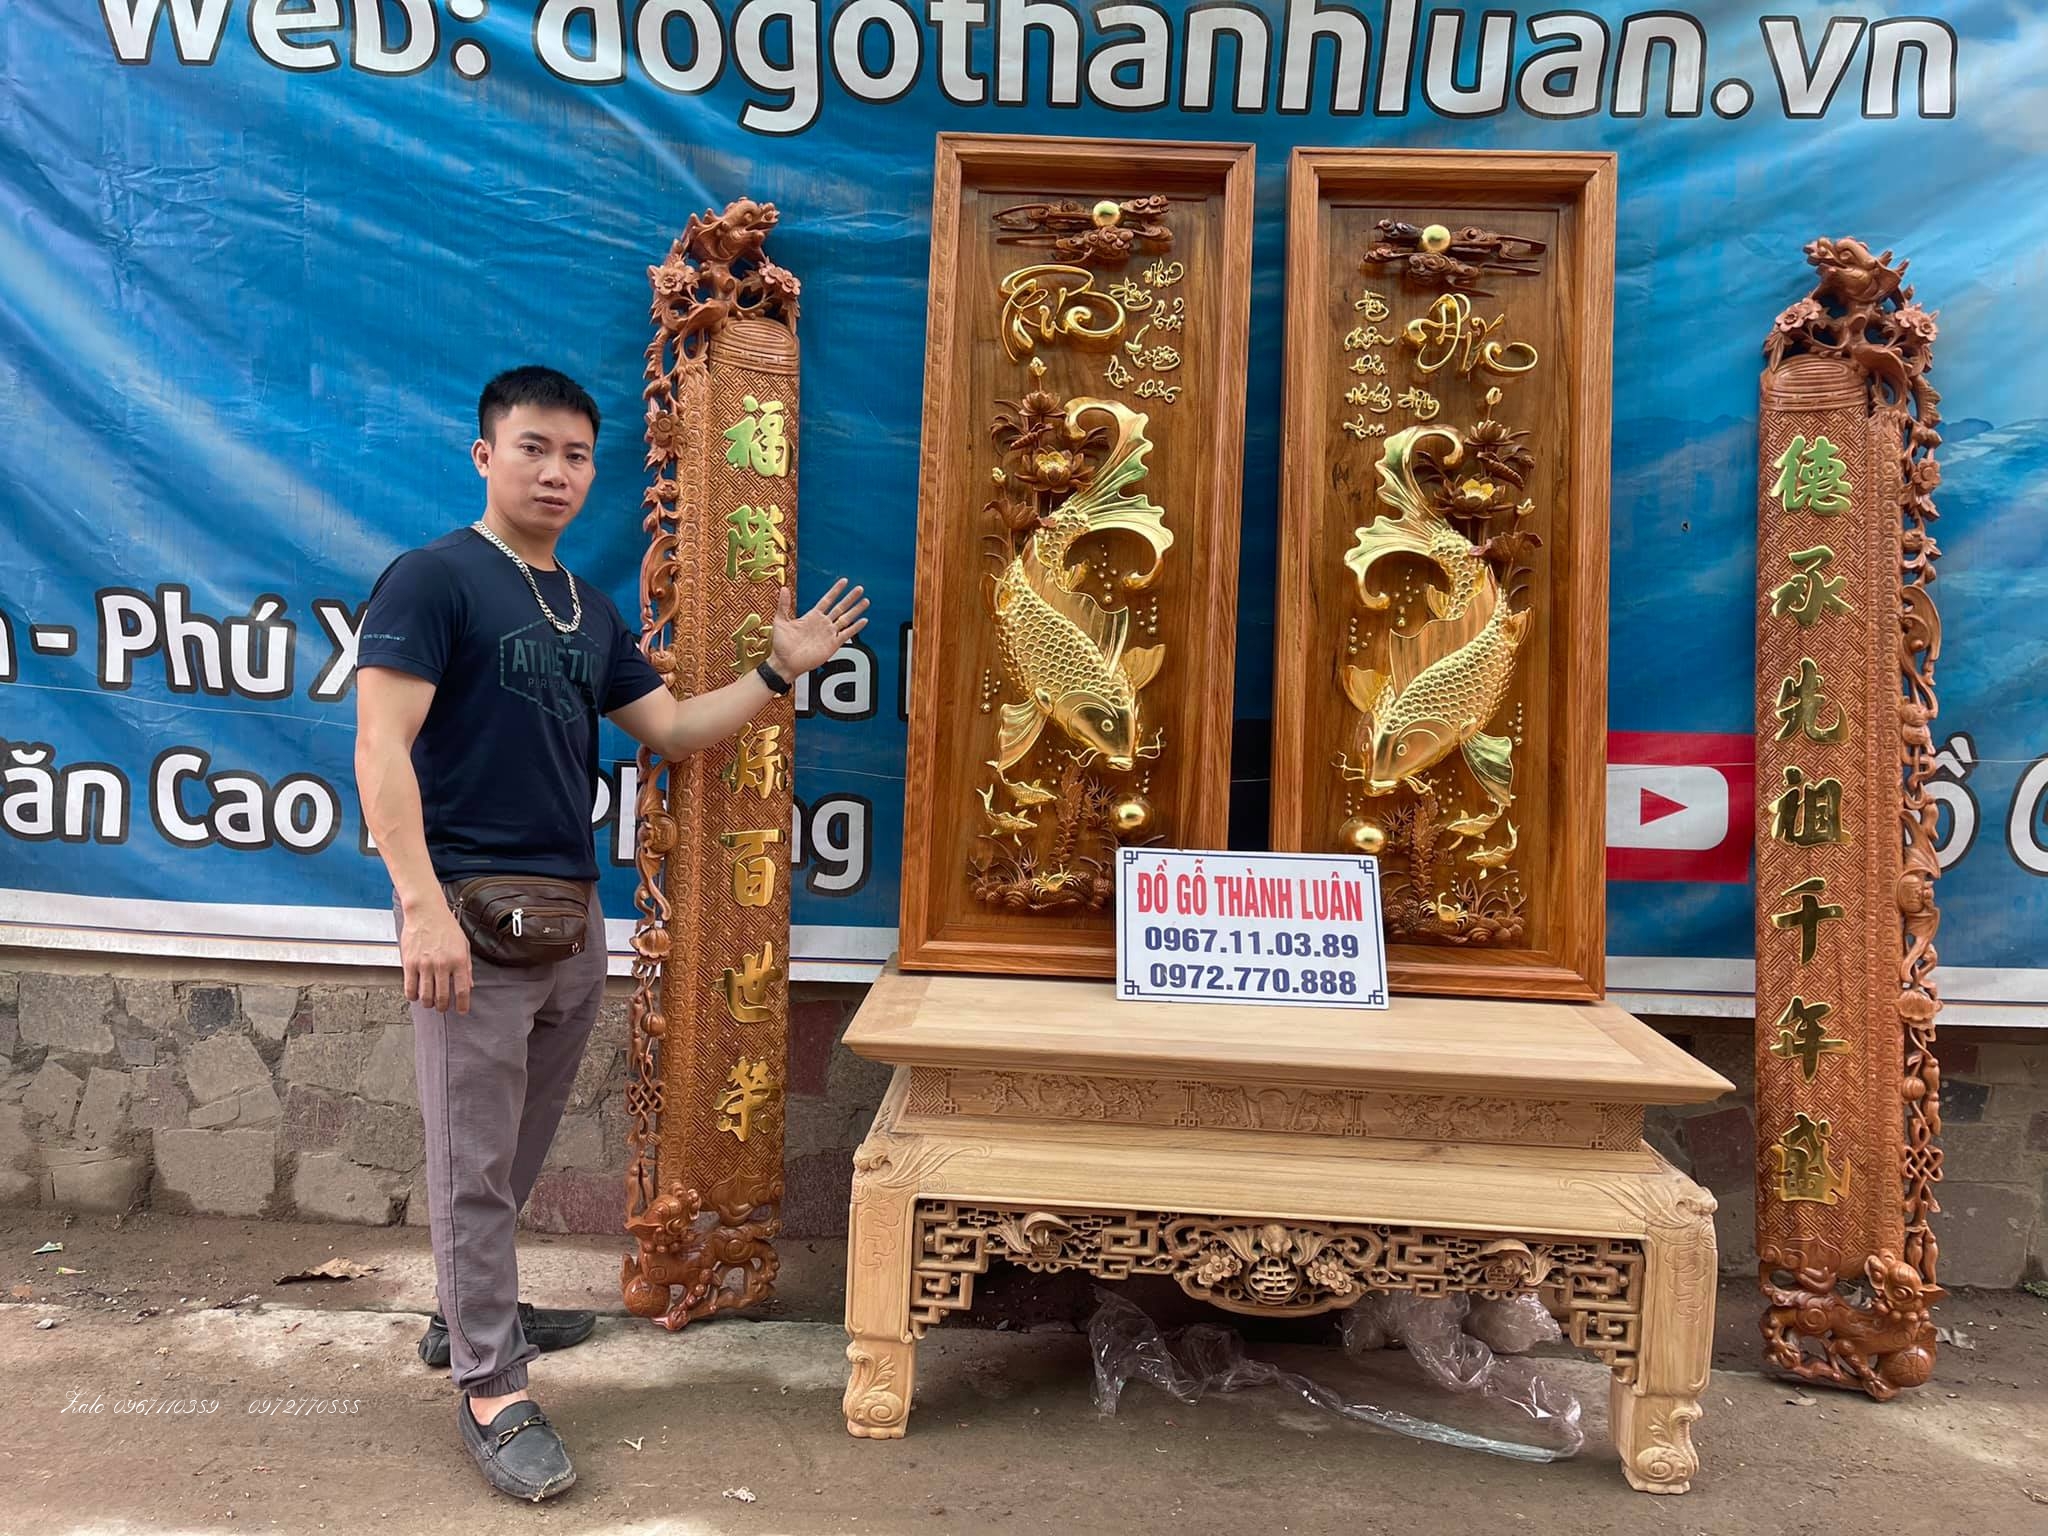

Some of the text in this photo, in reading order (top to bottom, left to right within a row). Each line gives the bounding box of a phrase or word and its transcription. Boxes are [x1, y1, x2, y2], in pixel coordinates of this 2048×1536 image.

[533, 0, 1958, 136] dogothanhluan.vn
[97, 585, 294, 699] Phú
[0, 742, 128, 844] ăn
[152, 748, 341, 855] Cao
[1137, 858, 1363, 921] ĐỒ GỖ THÀNH LUÂN
[1145, 926, 1359, 958] 0967.11.03.89
[1150, 963, 1357, 995] 0972.770.888
